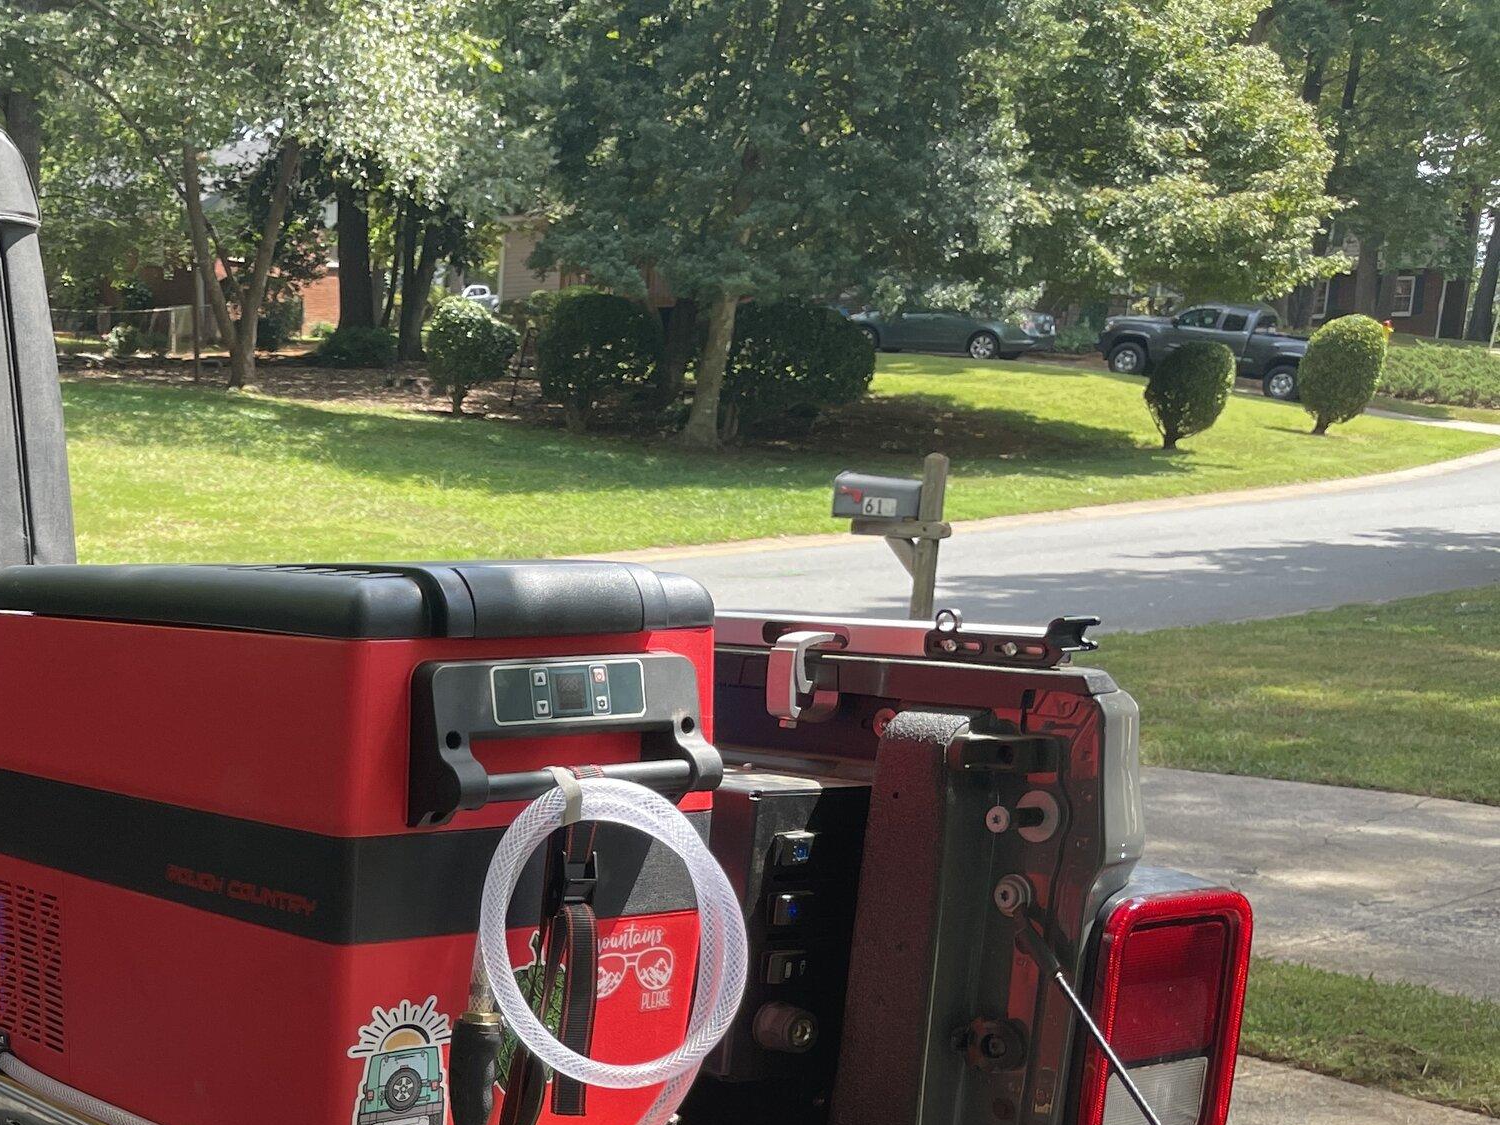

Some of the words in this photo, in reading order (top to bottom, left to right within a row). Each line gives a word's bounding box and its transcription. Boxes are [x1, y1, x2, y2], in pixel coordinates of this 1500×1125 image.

[165, 863, 224, 895] ROUGH
[226, 879, 318, 916] COUNTRY
[641, 989, 671, 1010] PLEASE
